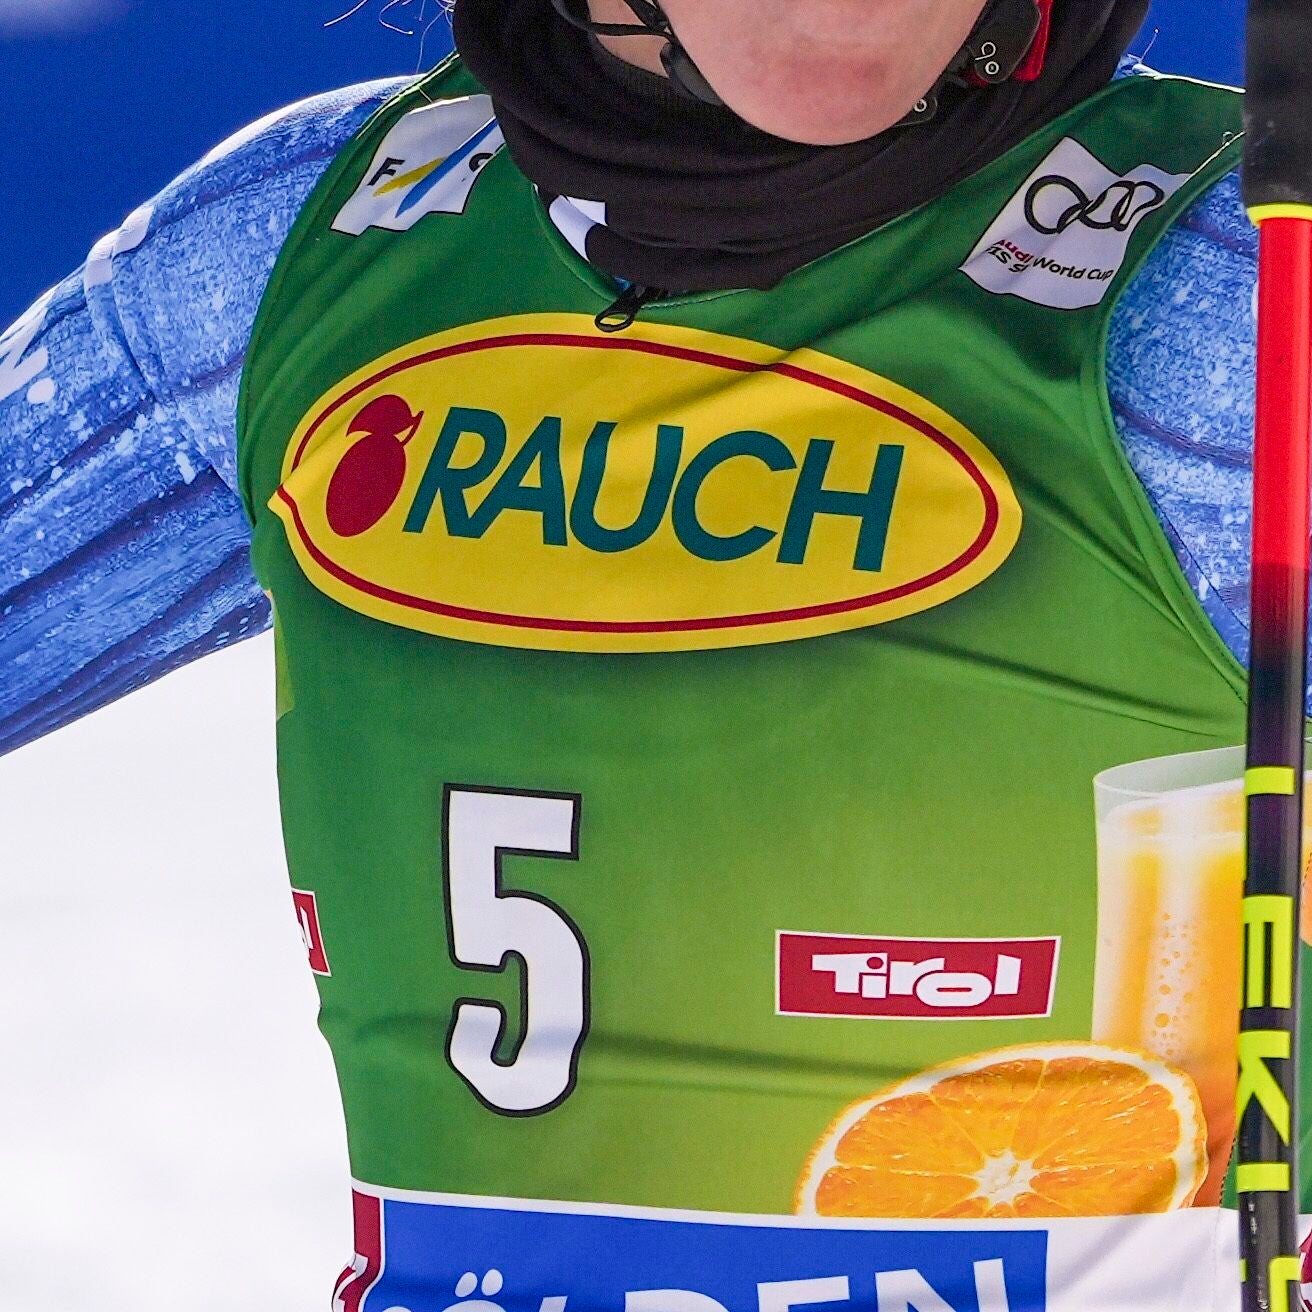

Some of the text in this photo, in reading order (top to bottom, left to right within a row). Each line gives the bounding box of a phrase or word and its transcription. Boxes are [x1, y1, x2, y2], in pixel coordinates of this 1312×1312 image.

[1033, 257, 1086, 279] World
[1087, 268, 1114, 282] Cup
[402, 406, 904, 573] RAUCH
[442, 783, 591, 1118] 5
[811, 952, 1022, 1008] Tirol
